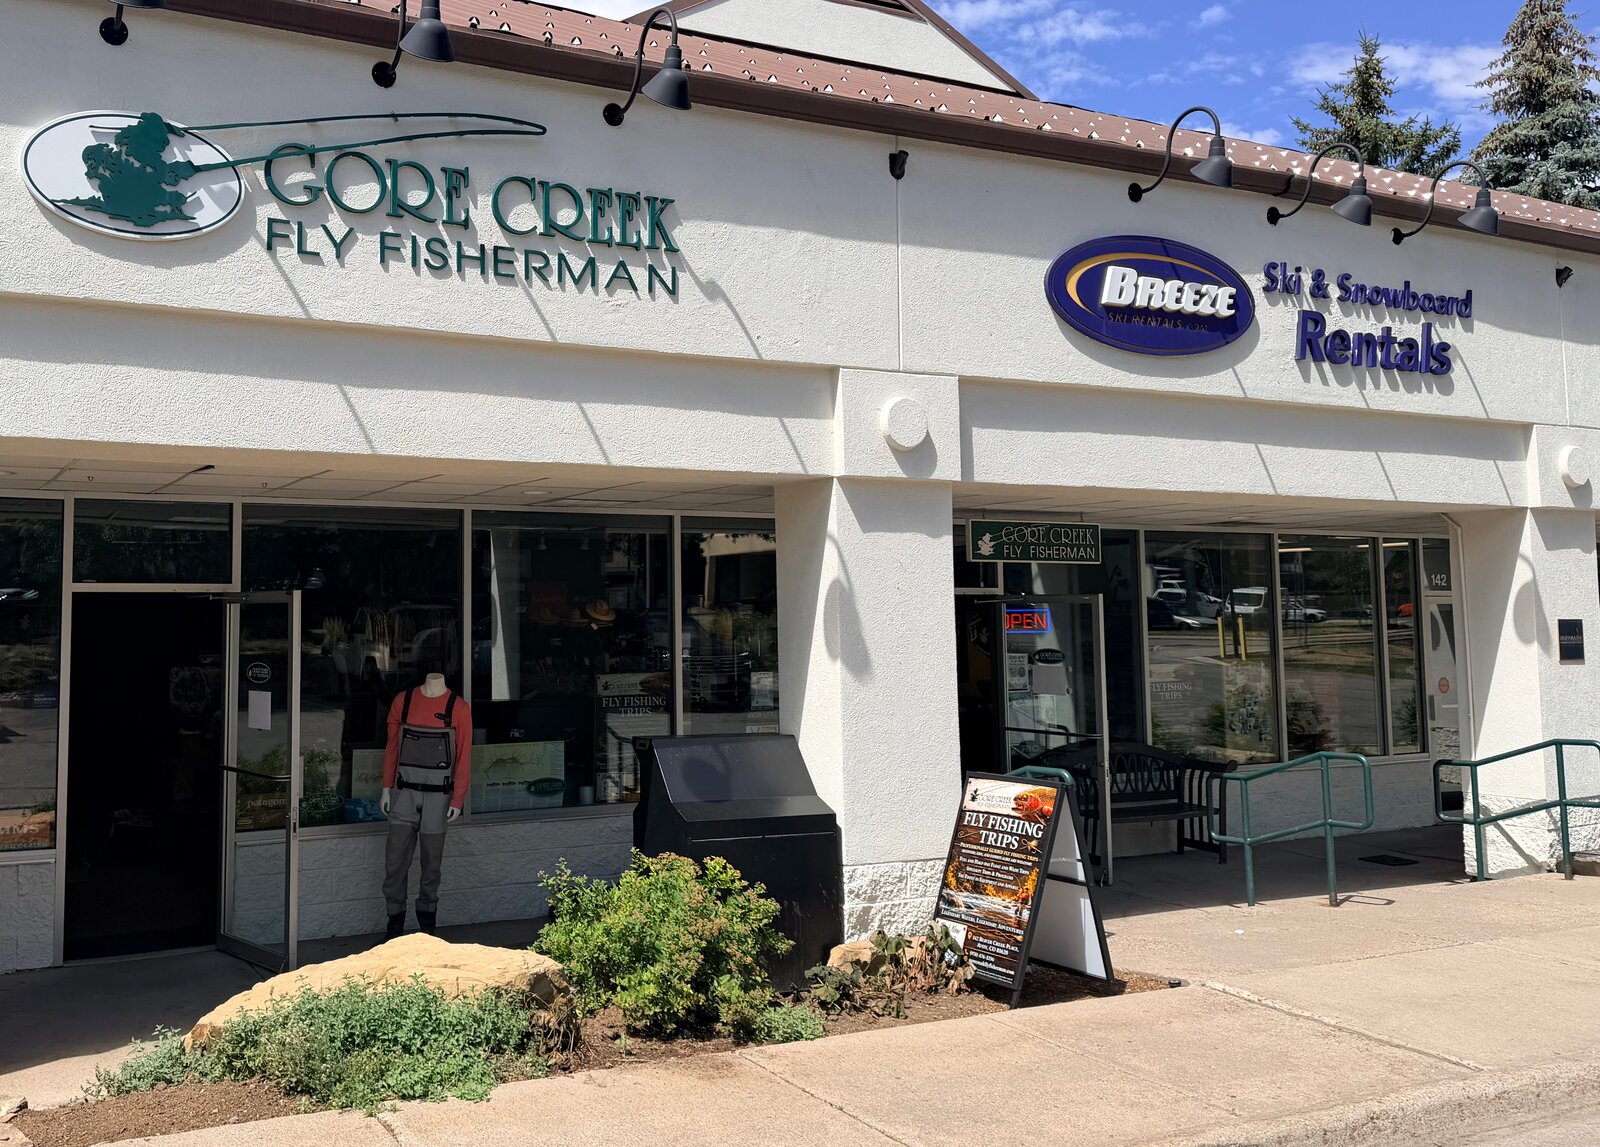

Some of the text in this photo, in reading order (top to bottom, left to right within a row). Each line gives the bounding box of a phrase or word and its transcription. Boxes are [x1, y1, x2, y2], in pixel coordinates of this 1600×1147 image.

[264, 143, 679, 252] GORE CREEK
[266, 217, 678, 297] FLY FISHERMAN
[1101, 265, 1237, 318] BREEZE
[1263, 262, 1473, 318] Ski & Snowboard
[1108, 312, 1127, 323] SKI
[1296, 309, 1452, 376] Rentals
[1002, 525, 1095, 545] GORE CREEK
[1003, 545, 1095, 559] FLY FISHERMAN
[1431, 574, 1447, 586] 142
[602, 696, 667, 707] FLY FISHING
[1160, 691, 1183, 700] TRIPS
[619, 707, 652, 717] TRIPS
[963, 812, 1044, 838] FLY FISHING
[980, 830, 1019, 849] TRIPS
